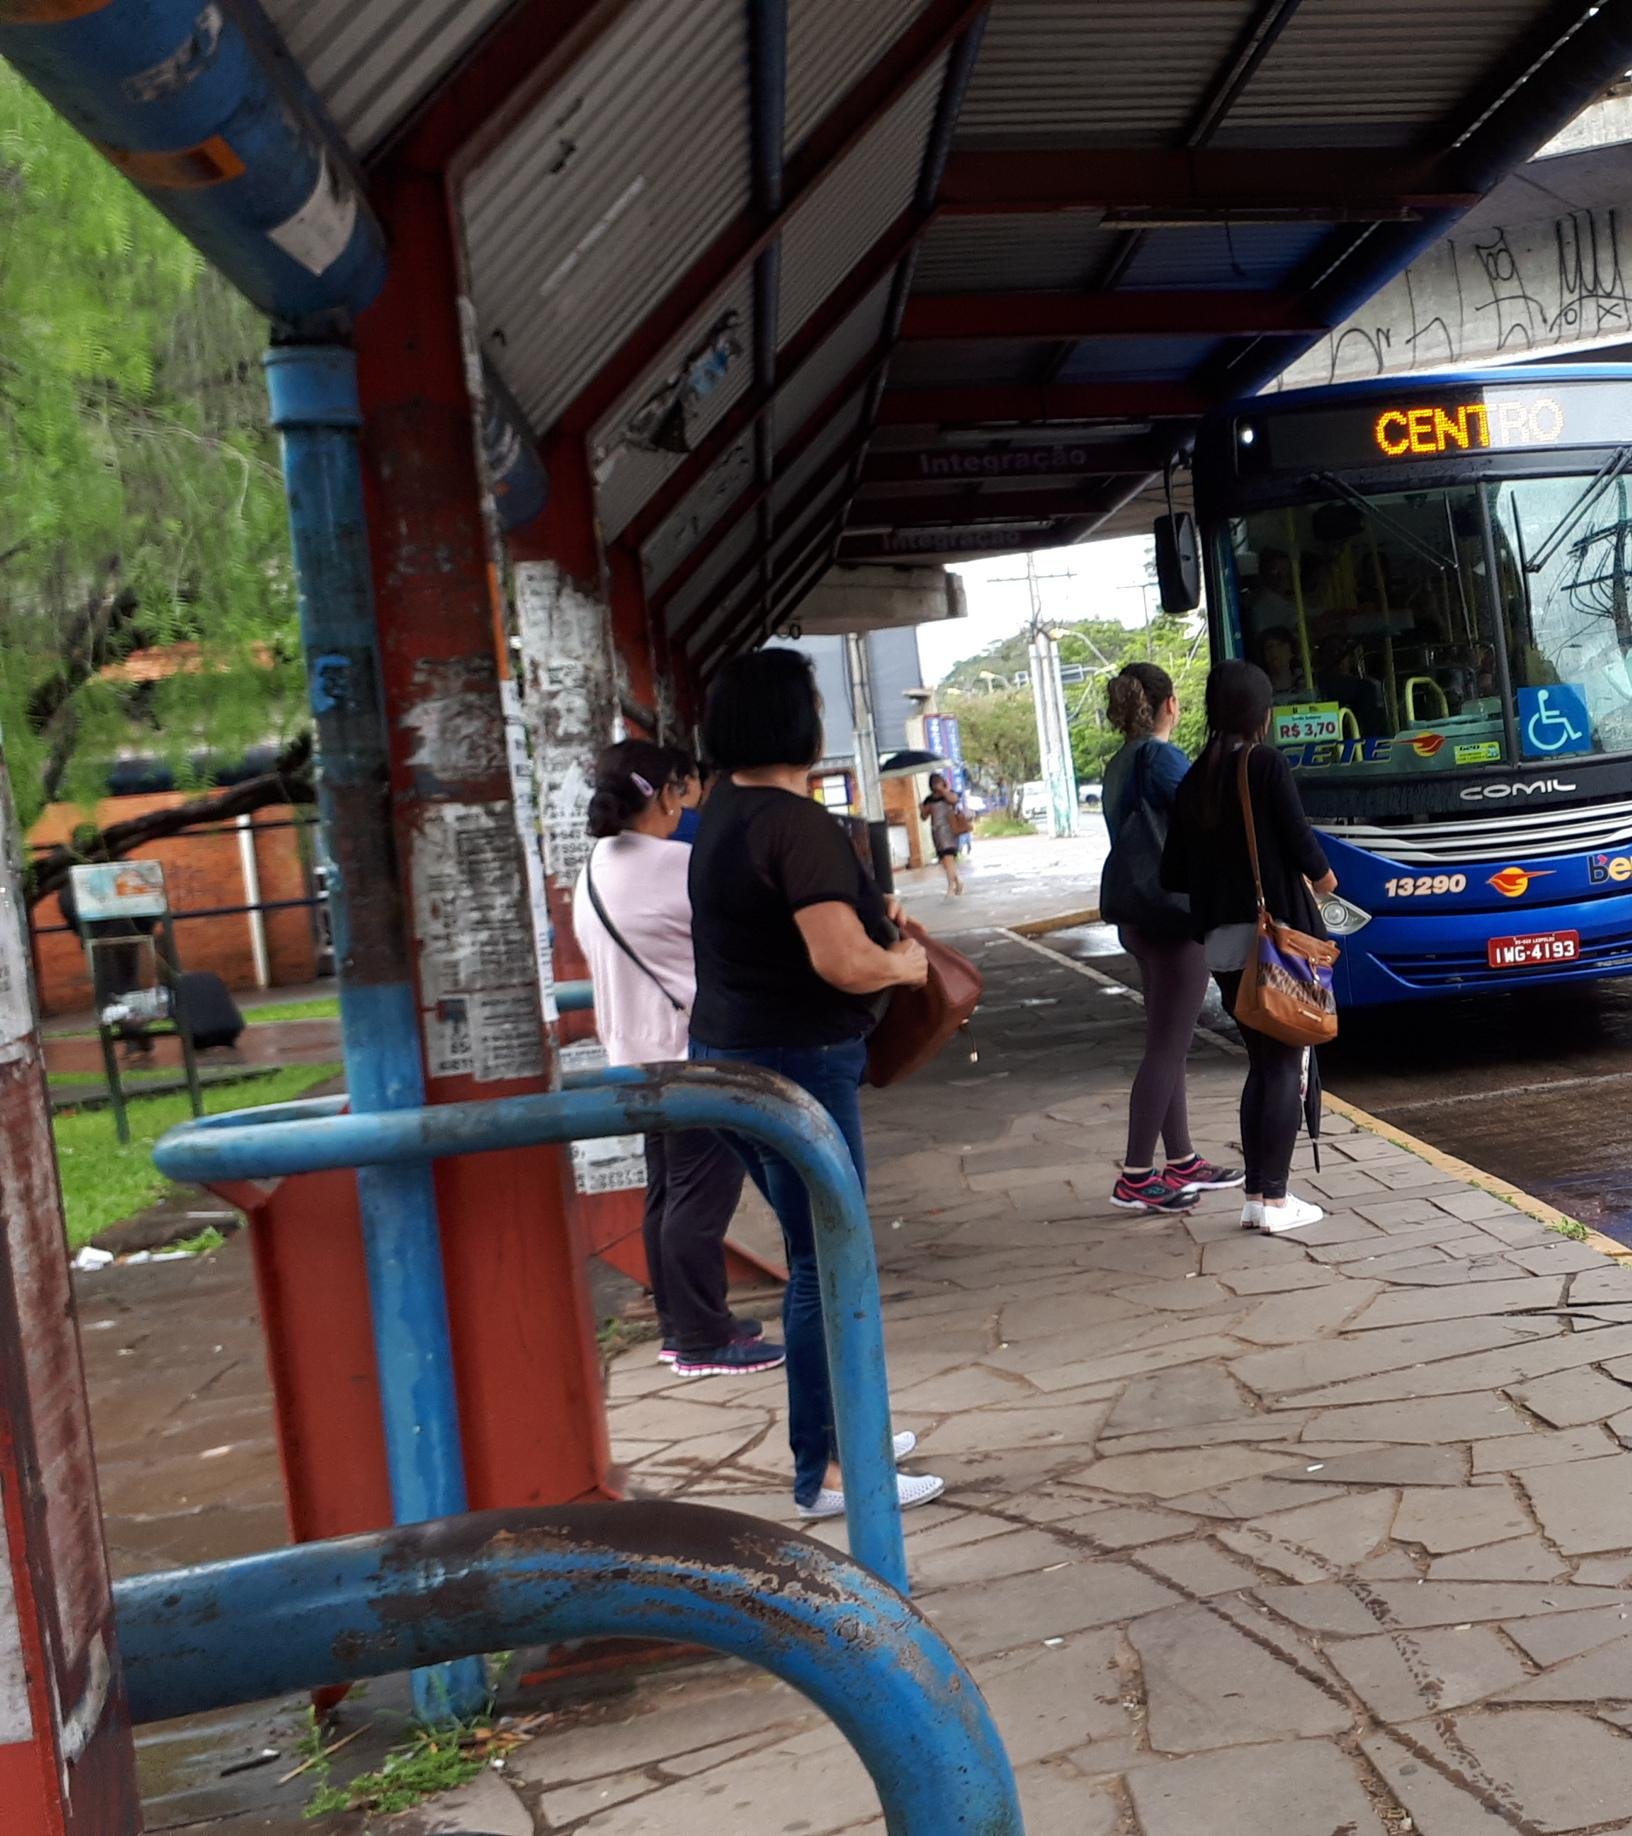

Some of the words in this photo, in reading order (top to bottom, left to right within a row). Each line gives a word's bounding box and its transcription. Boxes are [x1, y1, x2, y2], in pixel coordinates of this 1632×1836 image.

[1375, 398, 1563, 456] CENTRO
[919, 446, 1088, 474] Integração
[1280, 723, 1300, 739] R$
[1304, 721, 1336, 738] 3,70
[1460, 779, 1576, 800] COMIL
[1385, 873, 1467, 898] 13290
